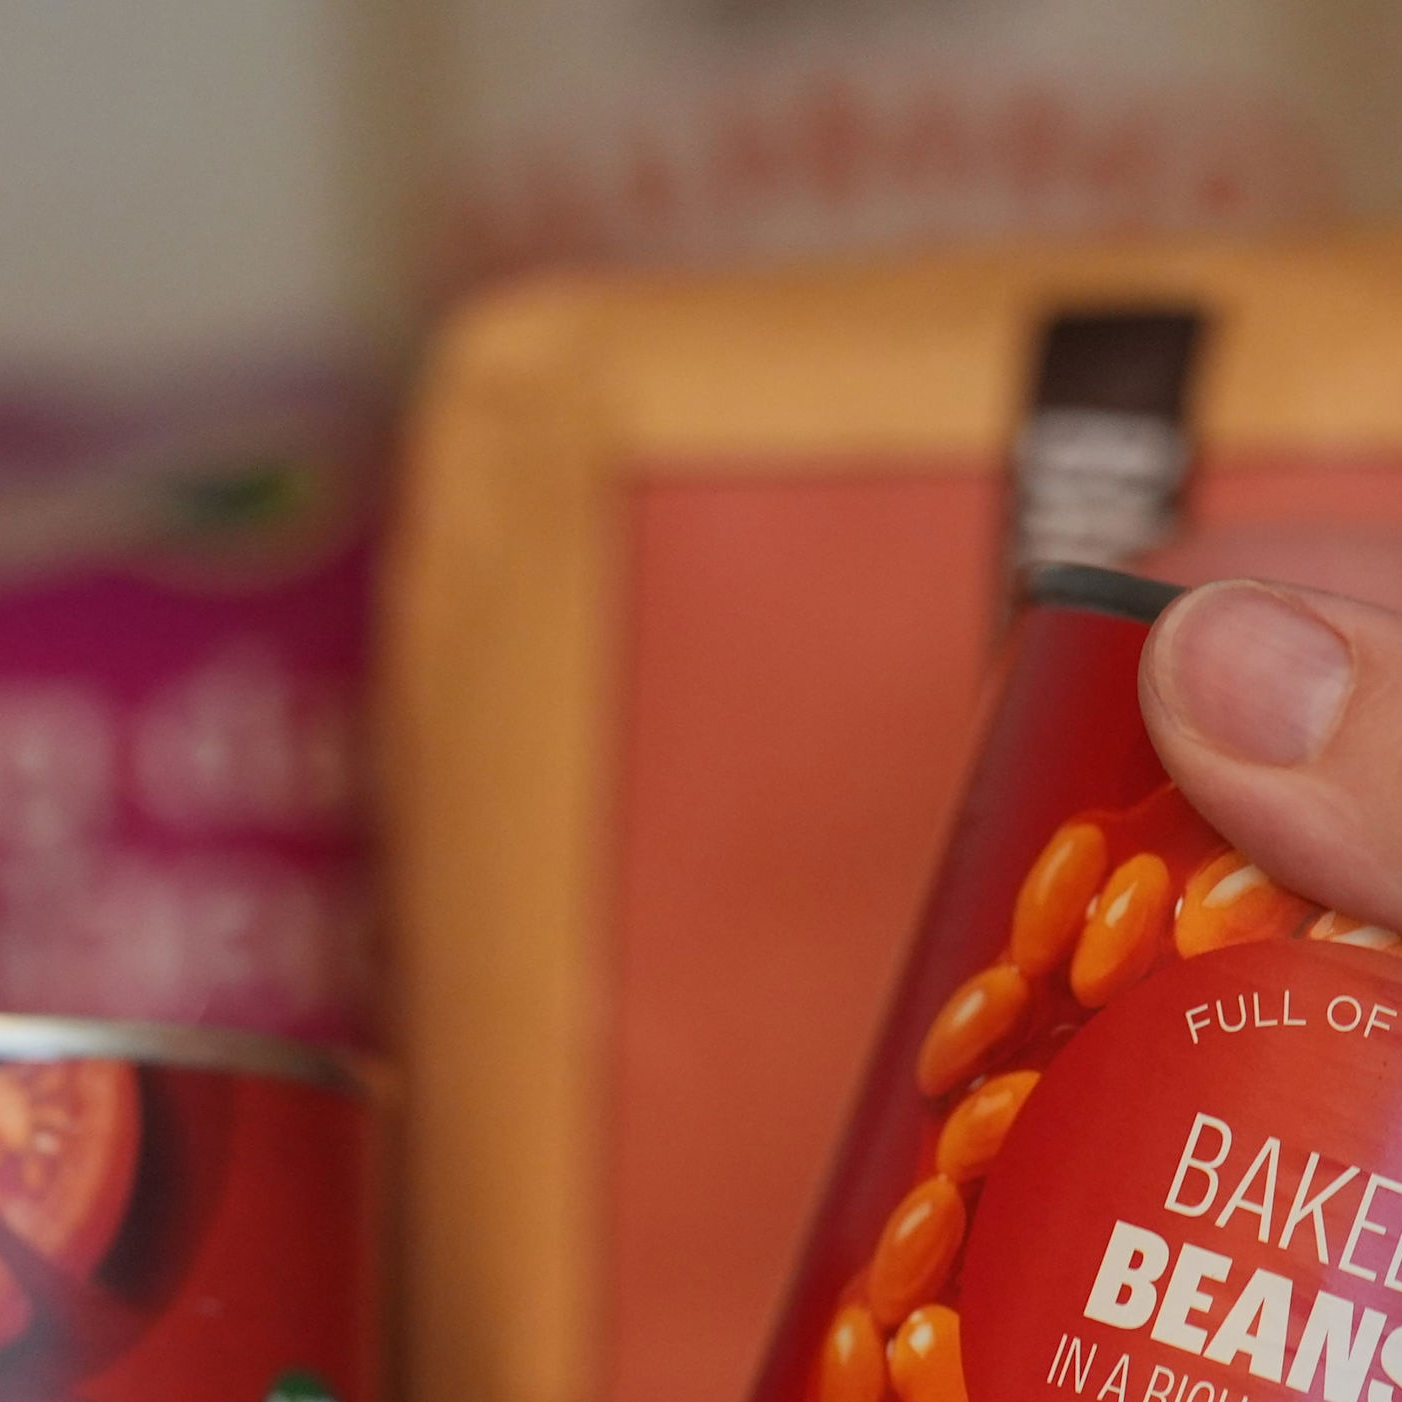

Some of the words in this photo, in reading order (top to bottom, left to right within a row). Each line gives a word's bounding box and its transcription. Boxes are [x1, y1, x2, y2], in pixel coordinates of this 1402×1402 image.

[1184, 990, 1306, 1045] FULL
[1326, 995, 1398, 1040] OF
[1047, 1334, 1098, 1394] IN
